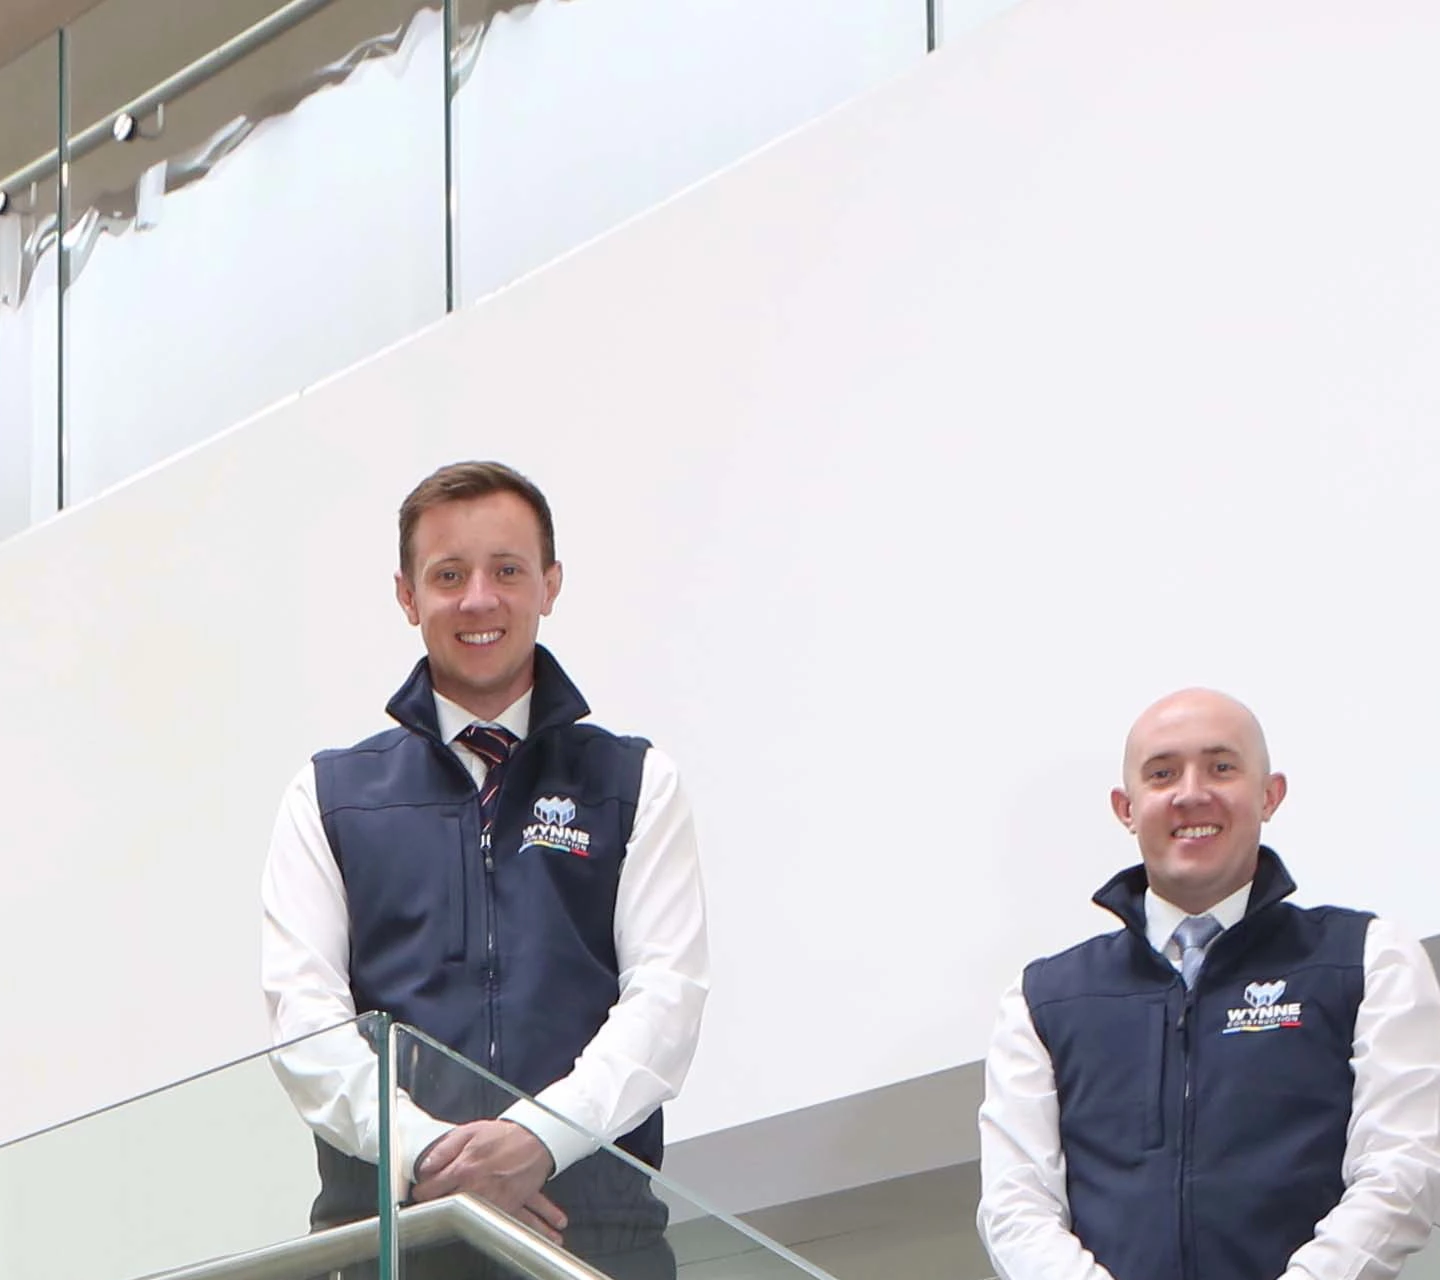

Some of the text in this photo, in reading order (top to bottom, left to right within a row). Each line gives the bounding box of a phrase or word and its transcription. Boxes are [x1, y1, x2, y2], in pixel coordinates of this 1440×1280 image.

[522, 823, 591, 846] WYNNE
[523, 834, 588, 851] NSTRUCTION
[1226, 1003, 1302, 1021] WYNNE
